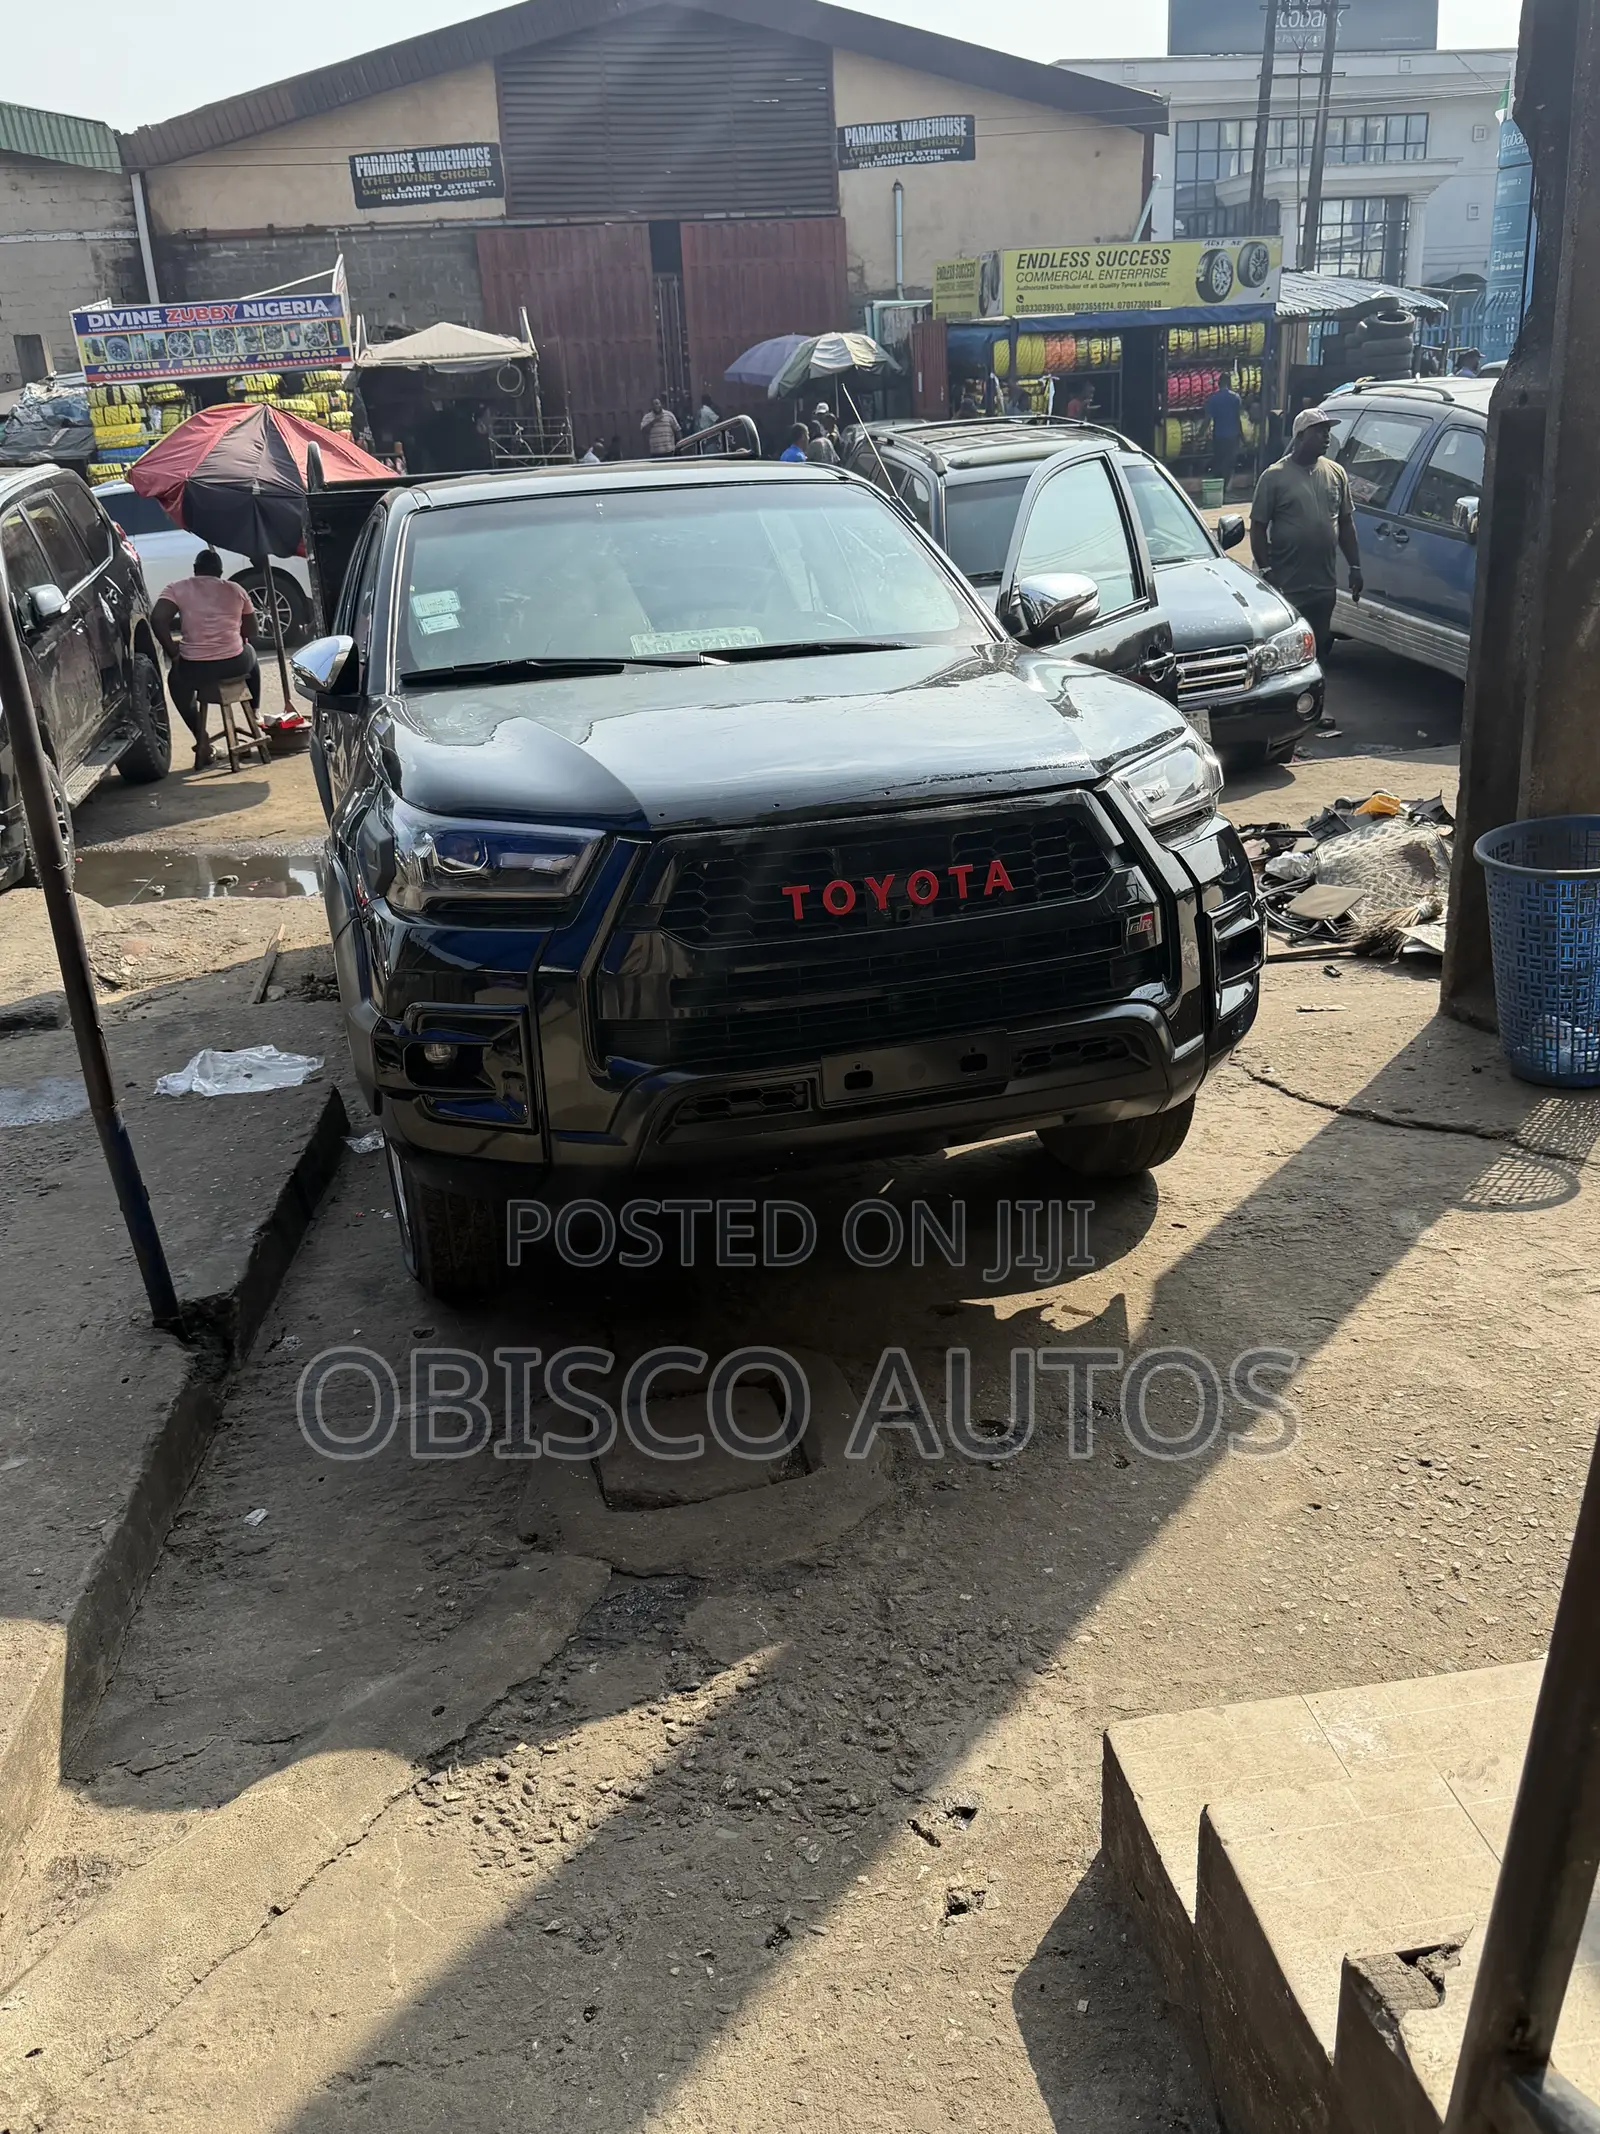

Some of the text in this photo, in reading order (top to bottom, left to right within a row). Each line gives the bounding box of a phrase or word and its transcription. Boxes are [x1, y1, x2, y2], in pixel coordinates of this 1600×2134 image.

[845, 117, 967, 147] PARADISE WAREHOUSE
[874, 150, 913, 160] LADIPO
[878, 142, 915, 153] DIVINE
[355, 147, 492, 177] PARADISE WAREHOUSE
[859, 159, 903, 169] MUSHIN
[361, 168, 490, 188] (THE DIVINE CHOICE)
[398, 184, 442, 193] LADIPO
[447, 180, 496, 189] STREET,
[381, 188, 480, 200] MUSHIN LAGOS.
[1017, 249, 1171, 270] ENDLESS SUCCESS
[1016, 267, 1168, 283] COMMERCIAL ENTERPRISE
[1099, 282, 1119, 290] Quality
[87, 311, 162, 328] DIVINE
[165, 304, 238, 323] ZUBBY
[243, 300, 329, 318] NIGERIA
[98, 361, 160, 373] AUSTONE
[182, 355, 248, 367] BEARWAY
[257, 353, 284, 361] AND
[292, 349, 339, 359] ROADX
[782, 860, 1014, 920] TOYOTA
